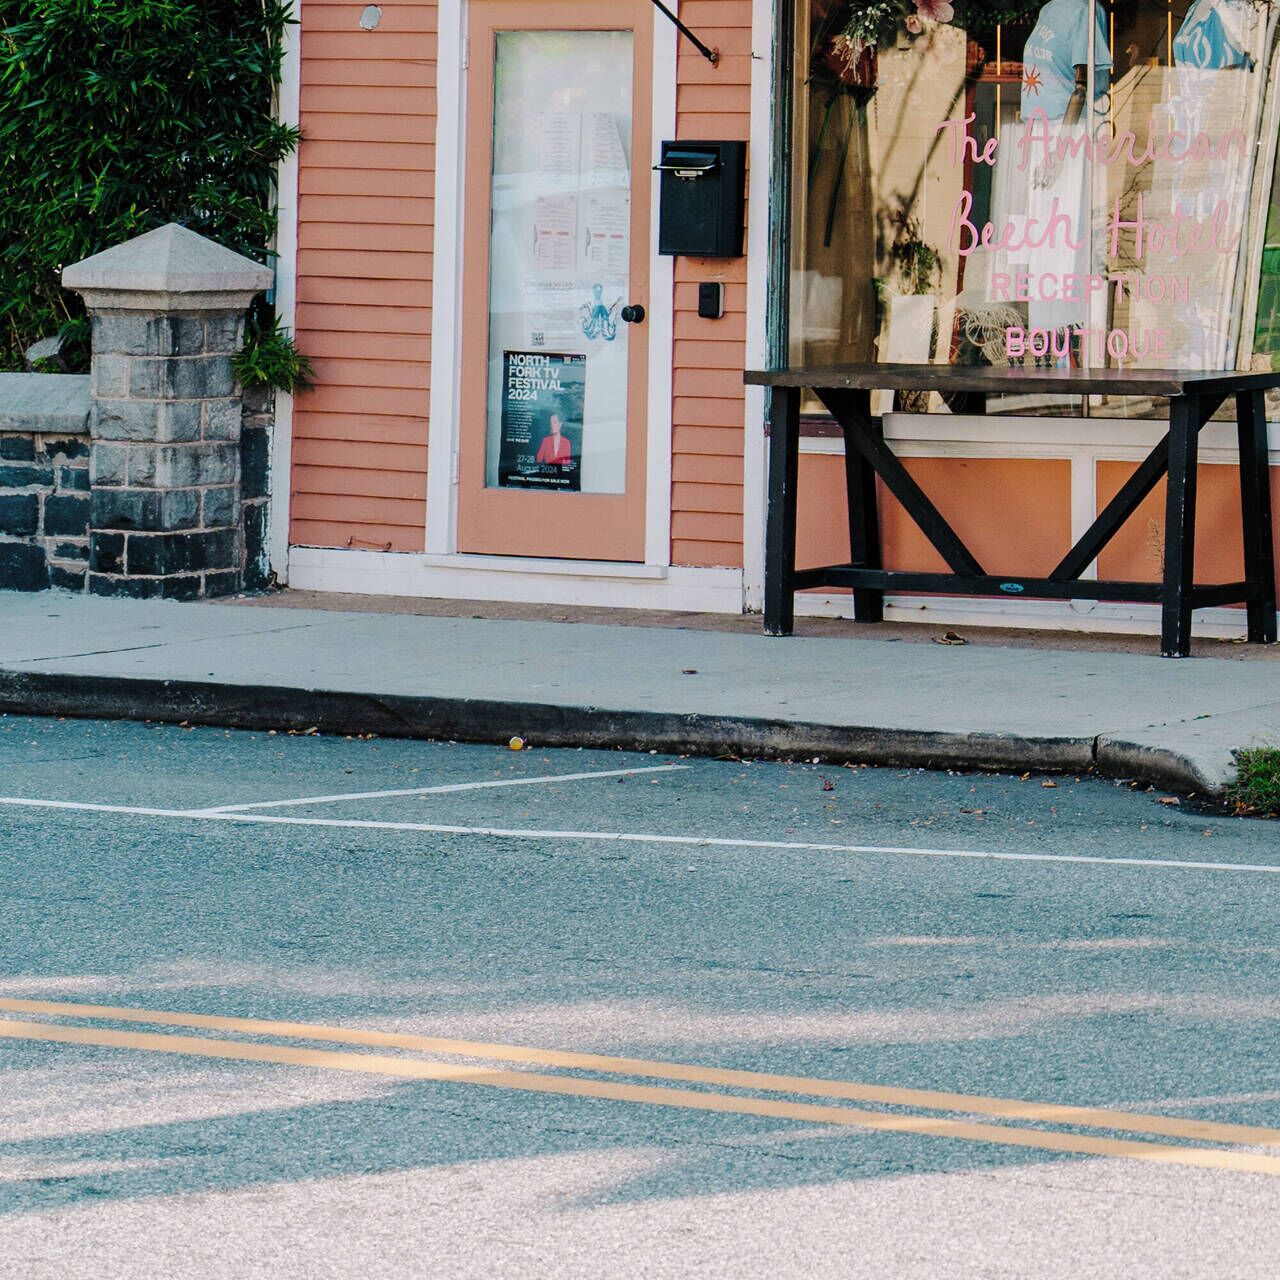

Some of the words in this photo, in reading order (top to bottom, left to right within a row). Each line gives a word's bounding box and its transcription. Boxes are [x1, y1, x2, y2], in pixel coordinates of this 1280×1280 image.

[937, 112, 1000, 169] The
[1017, 106, 1248, 172] American
[948, 190, 1086, 257] Beech
[1107, 191, 1241, 261] Hotel
[989, 272, 1190, 305] RECEPTION
[1005, 326, 1174, 360] BOUTIQUE
[509, 354, 550, 366] NORTH
[509, 366, 541, 378] FORK
[543, 367, 559, 379] TV
[508, 378, 565, 391] FESTIVAL
[508, 389, 538, 401] 2024
